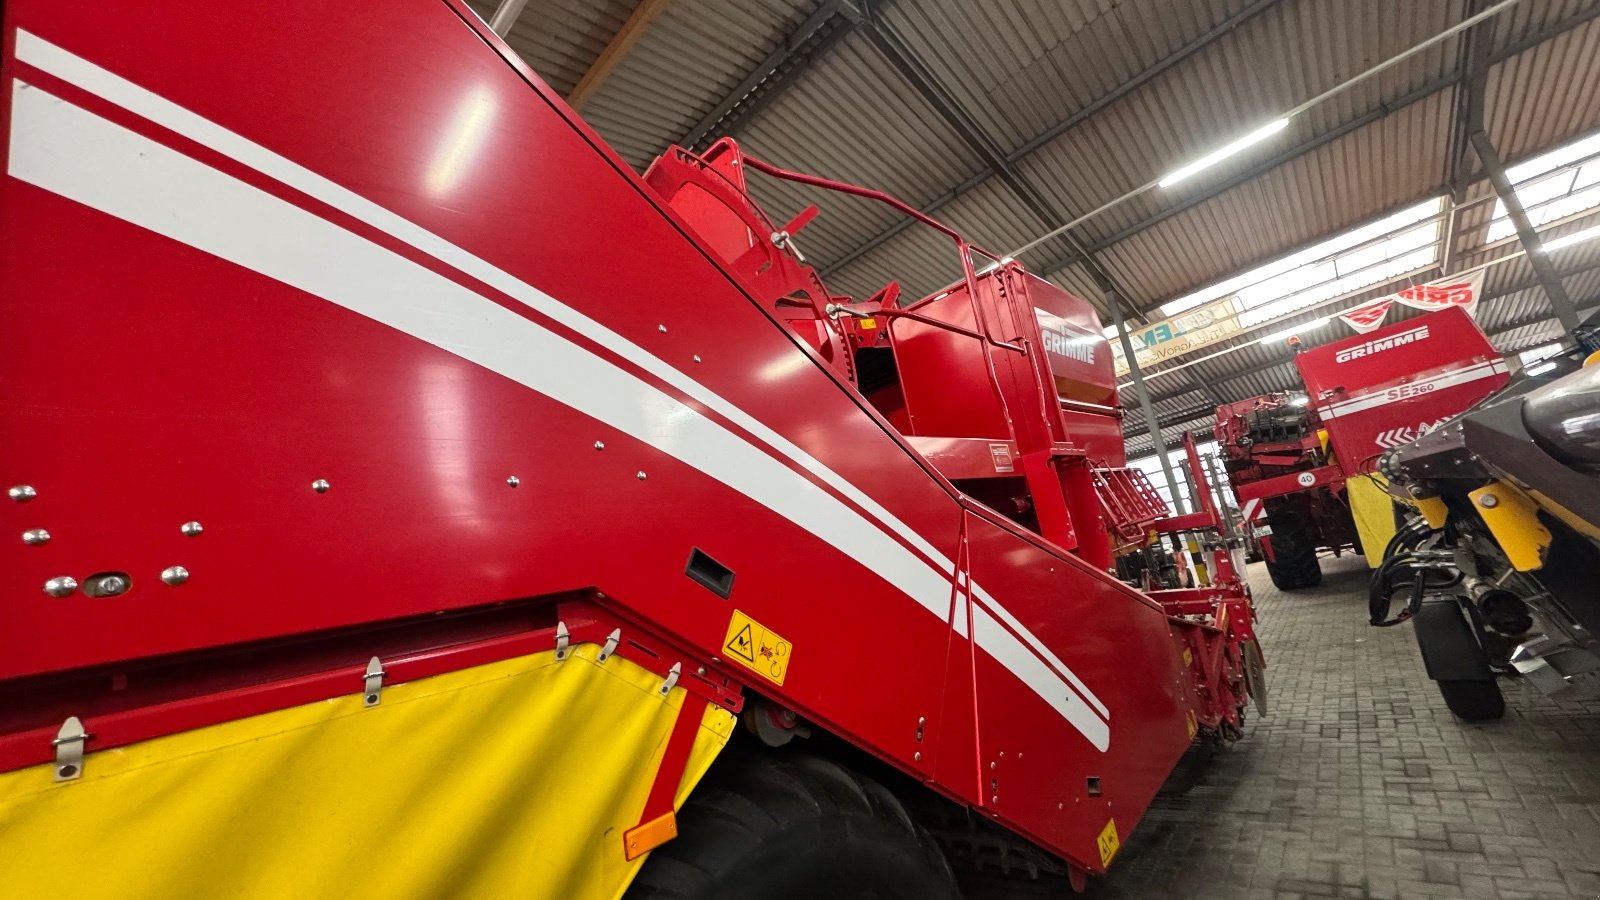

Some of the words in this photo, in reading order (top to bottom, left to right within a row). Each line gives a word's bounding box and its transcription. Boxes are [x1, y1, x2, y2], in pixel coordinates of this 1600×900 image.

[1042, 326, 1095, 364] GRIMME
[1336, 327, 1430, 363] GRIMME
[1387, 386, 1410, 400] SE
[1412, 384, 1434, 395] 260
[1301, 475, 1312, 483] 40
